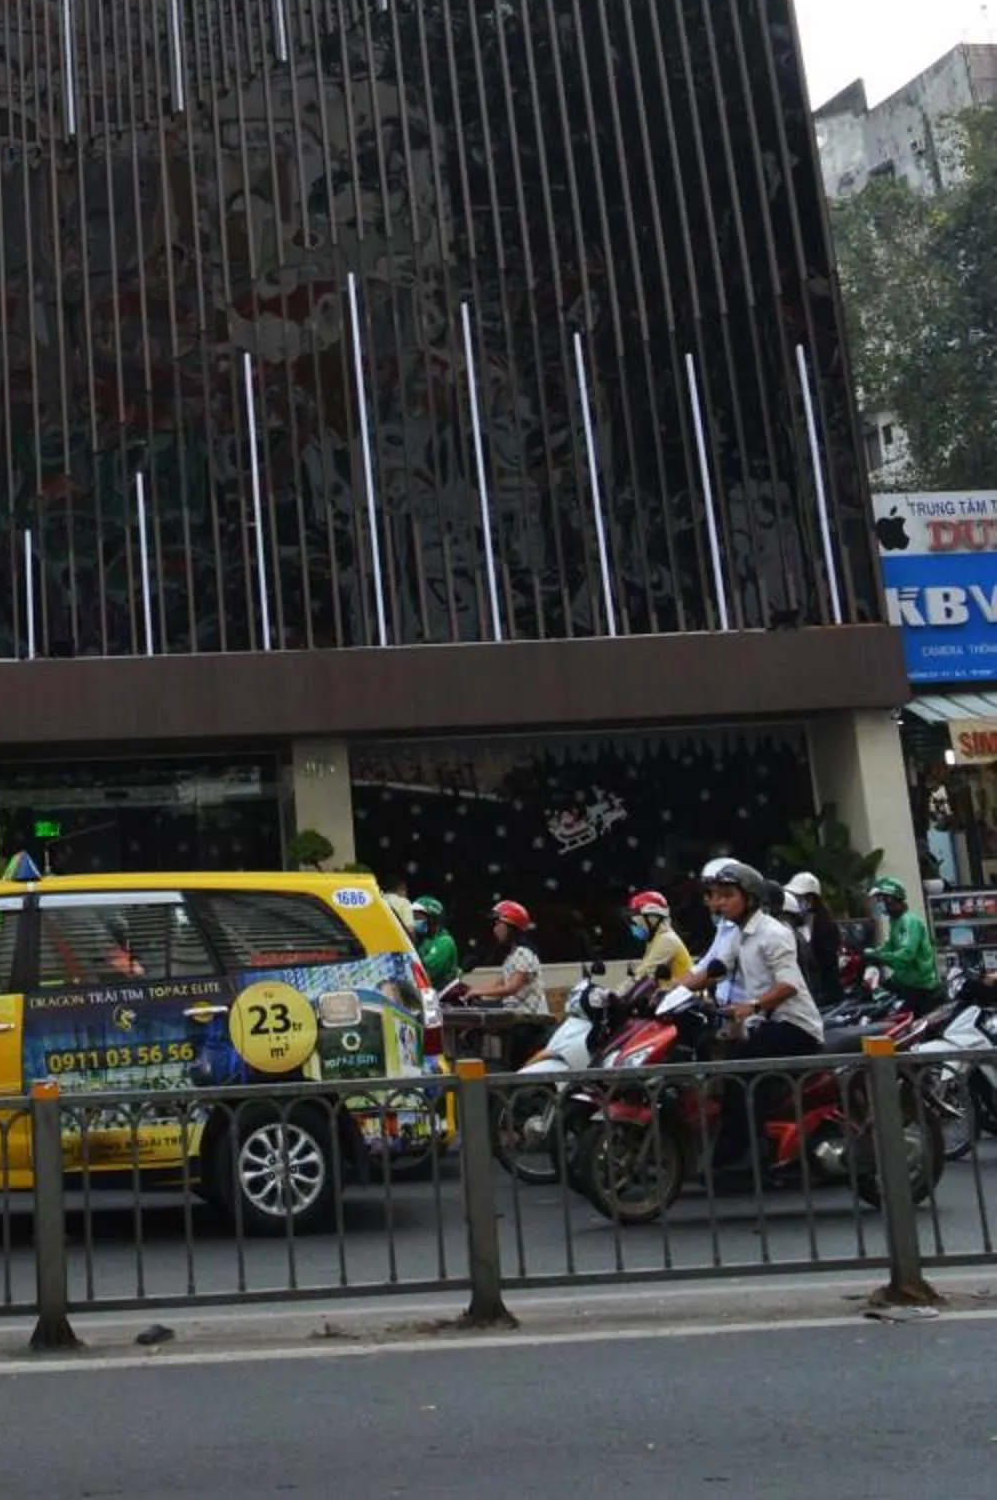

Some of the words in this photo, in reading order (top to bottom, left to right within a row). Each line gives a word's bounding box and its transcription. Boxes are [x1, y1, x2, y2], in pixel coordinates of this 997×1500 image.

[907, 500, 956, 516] TRUNG
[959, 498, 987, 515] TÂM
[148, 984, 188, 1000] TOPAZ
[190, 982, 221, 996] ELITE
[249, 1003, 291, 1036] 23
[49, 1050, 100, 1073] 0911
[106, 1048, 132, 1067] 03
[137, 1044, 163, 1064] 56
[168, 1042, 195, 1061] 56
